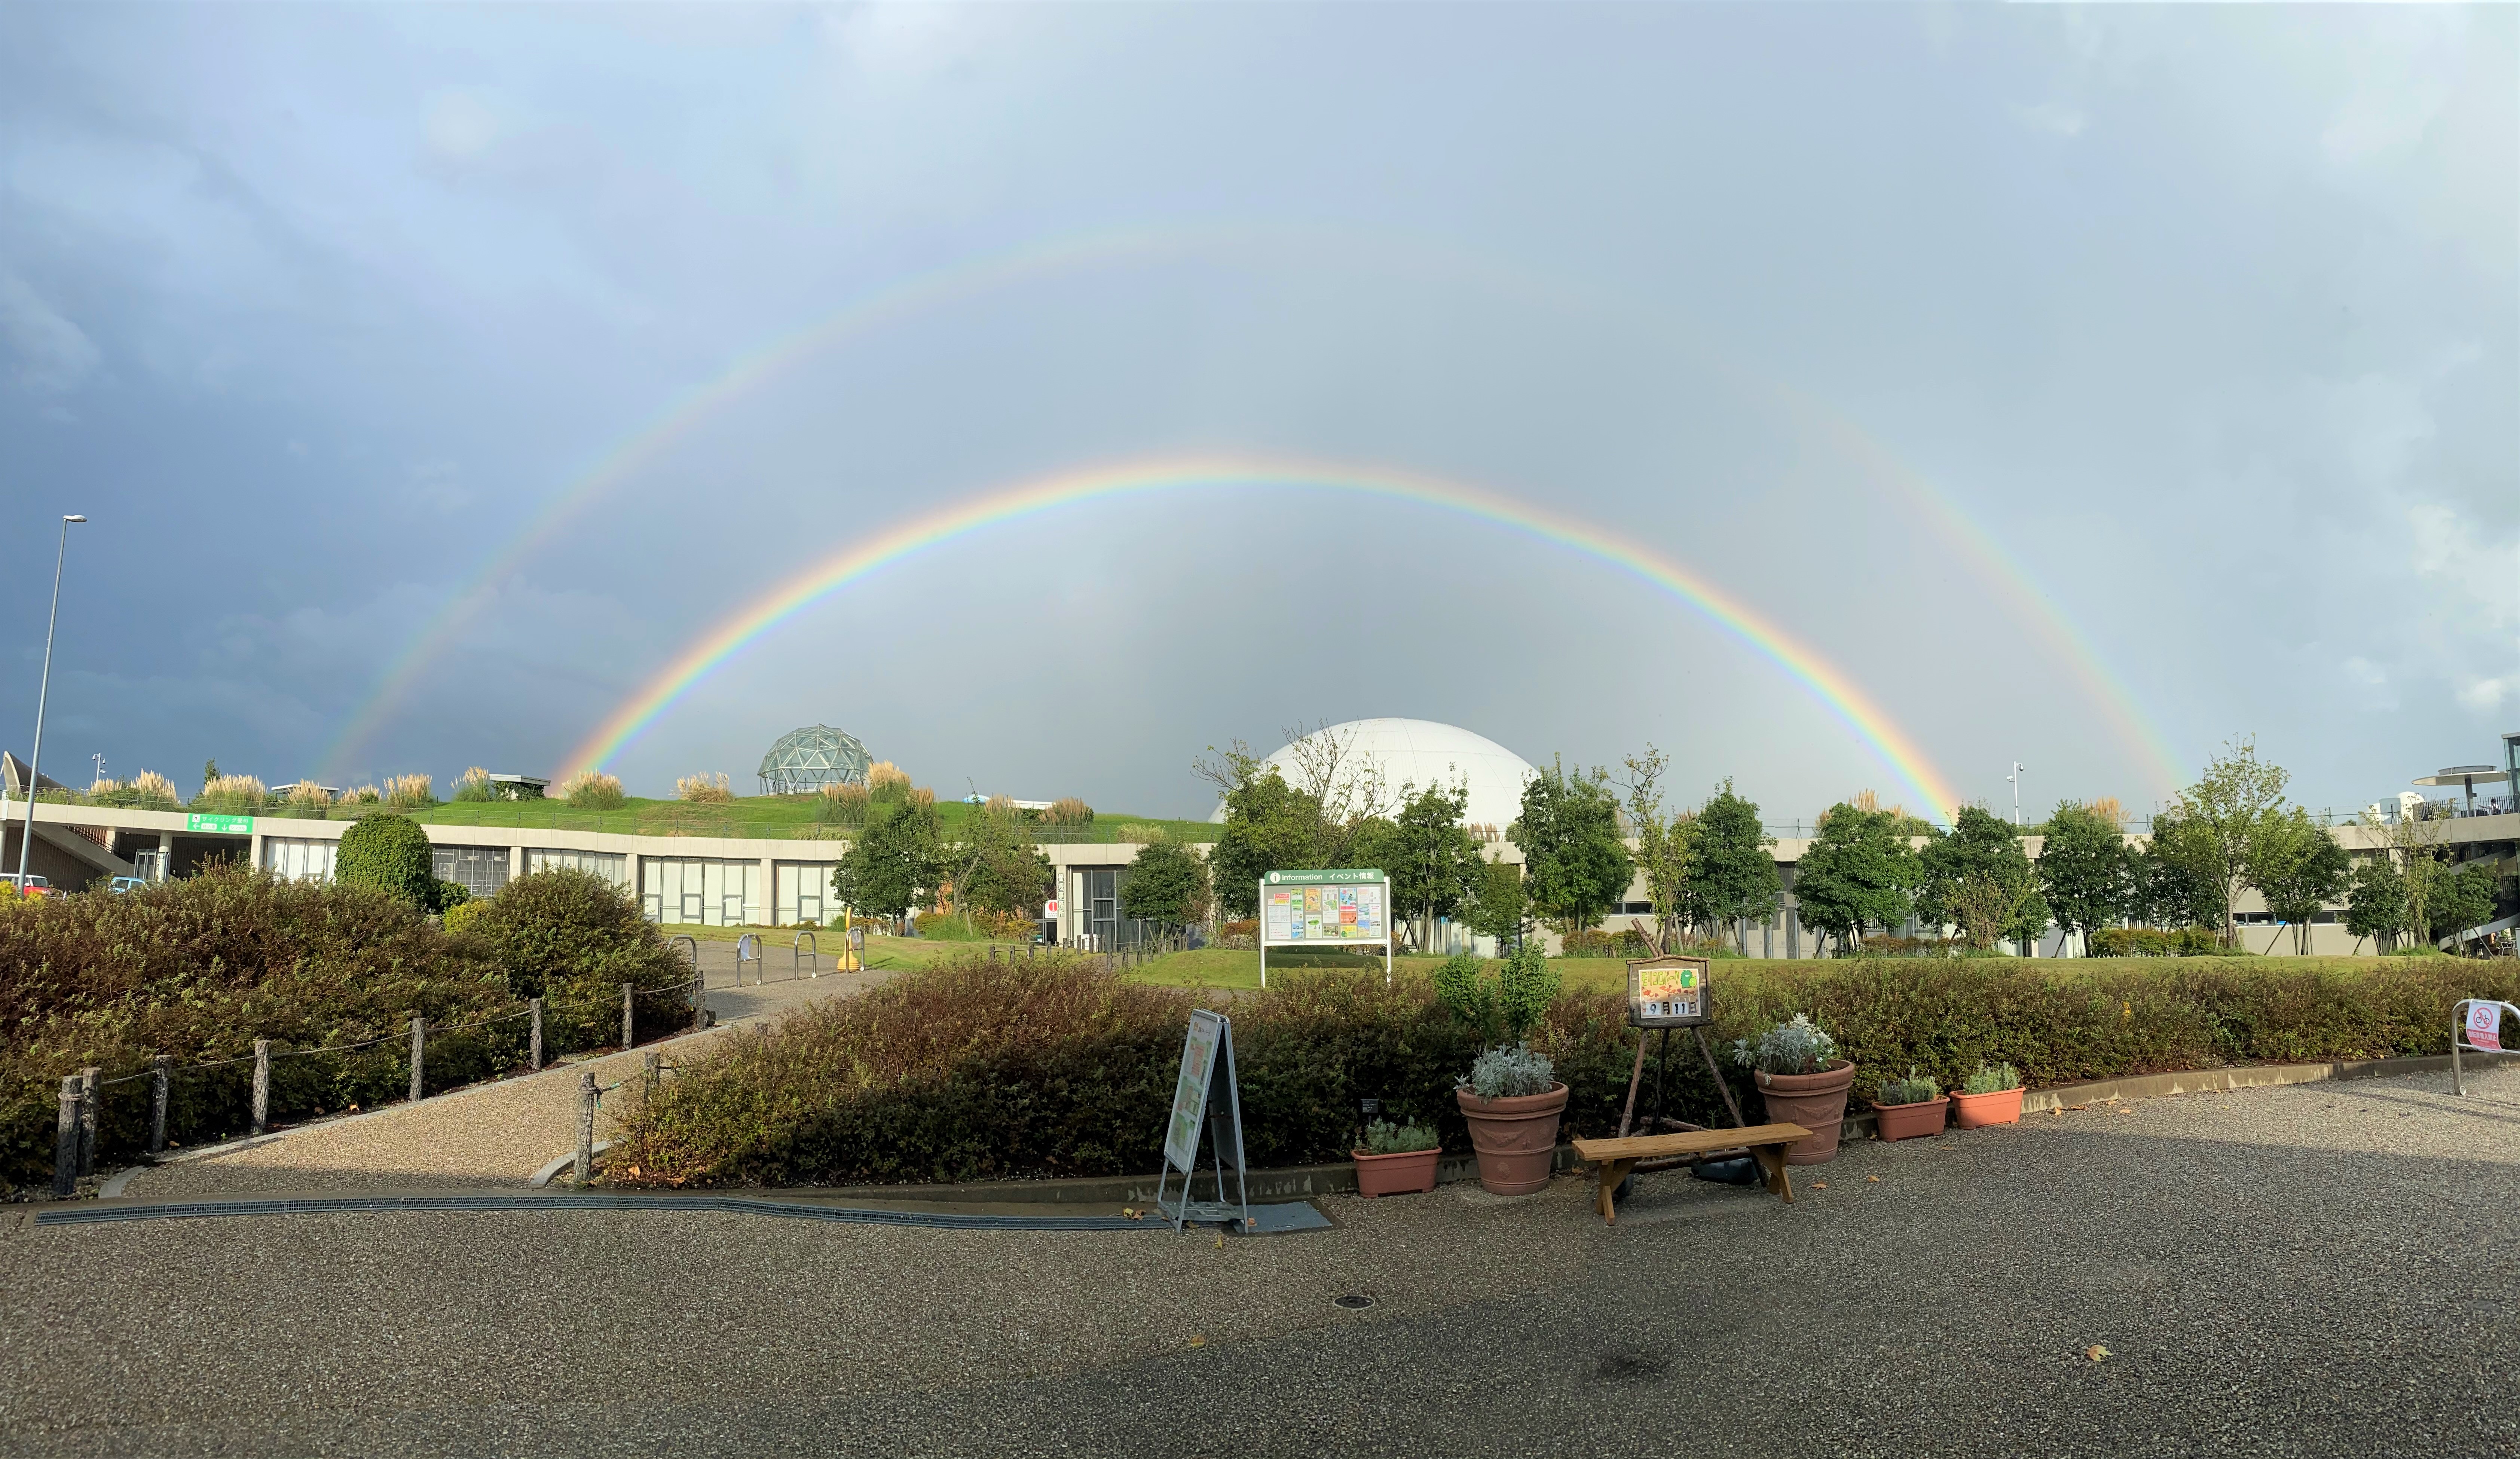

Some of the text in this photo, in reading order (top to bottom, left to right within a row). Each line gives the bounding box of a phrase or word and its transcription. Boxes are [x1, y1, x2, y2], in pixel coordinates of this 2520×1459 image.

[1329, 872, 1374, 880] イベント情報
[1642, 970, 1679, 986] モリコロパーク
